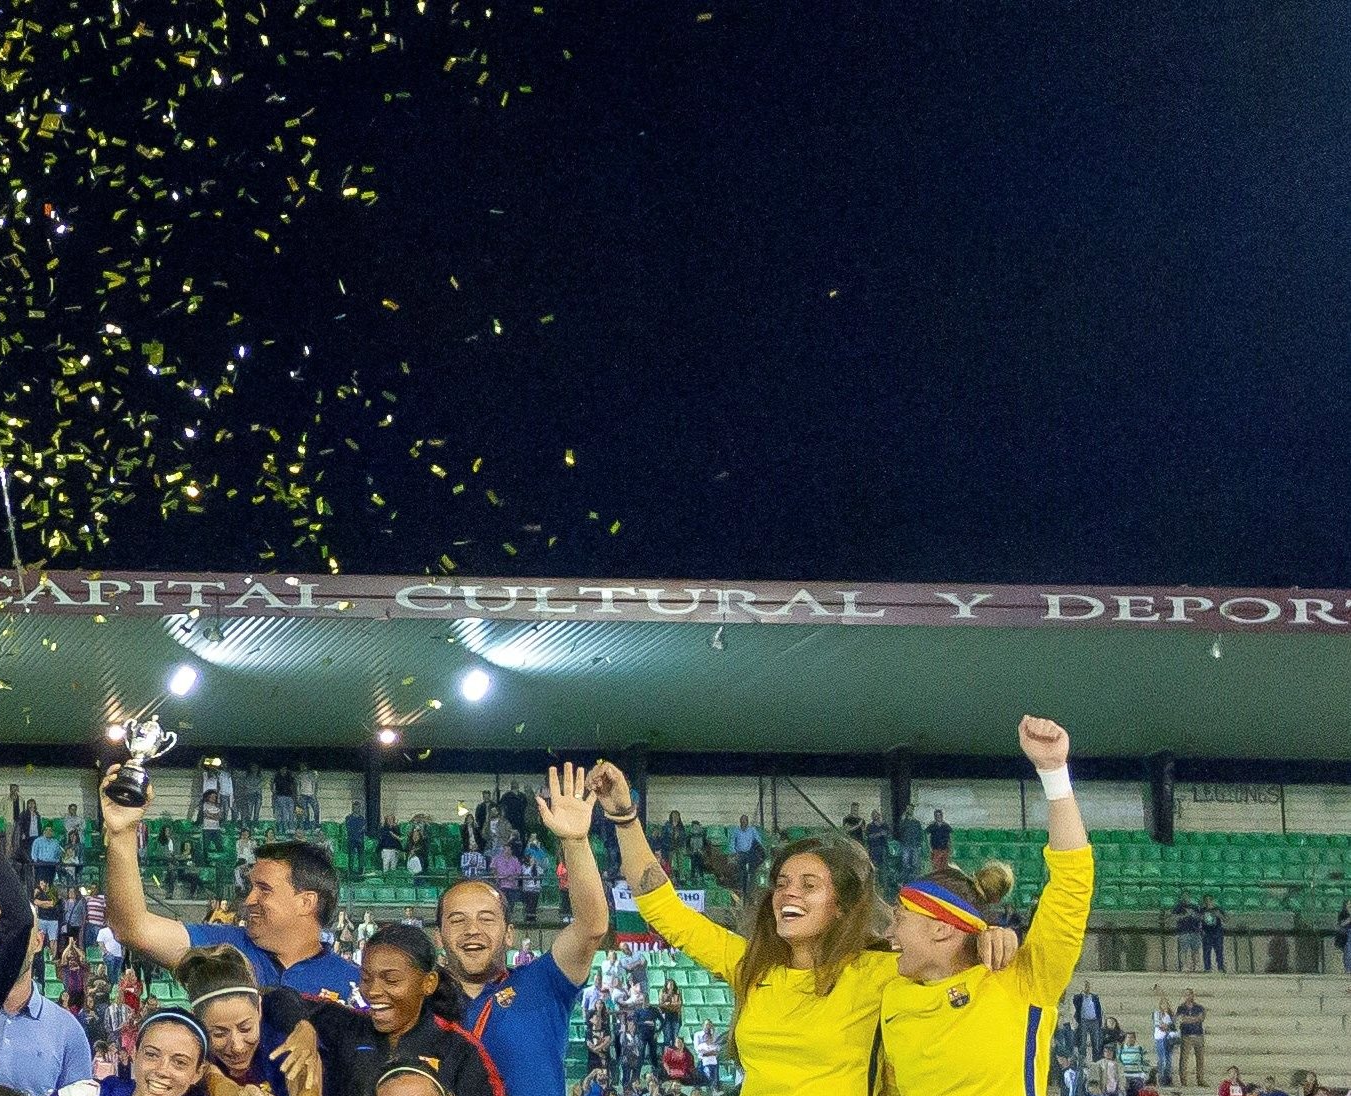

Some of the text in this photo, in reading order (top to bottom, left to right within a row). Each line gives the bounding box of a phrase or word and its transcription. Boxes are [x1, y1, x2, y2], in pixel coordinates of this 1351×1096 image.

[393, 584, 887, 619] CULTURAL
[936, 594, 994, 619] Y
[1040, 594, 1351, 625] DEPOR
